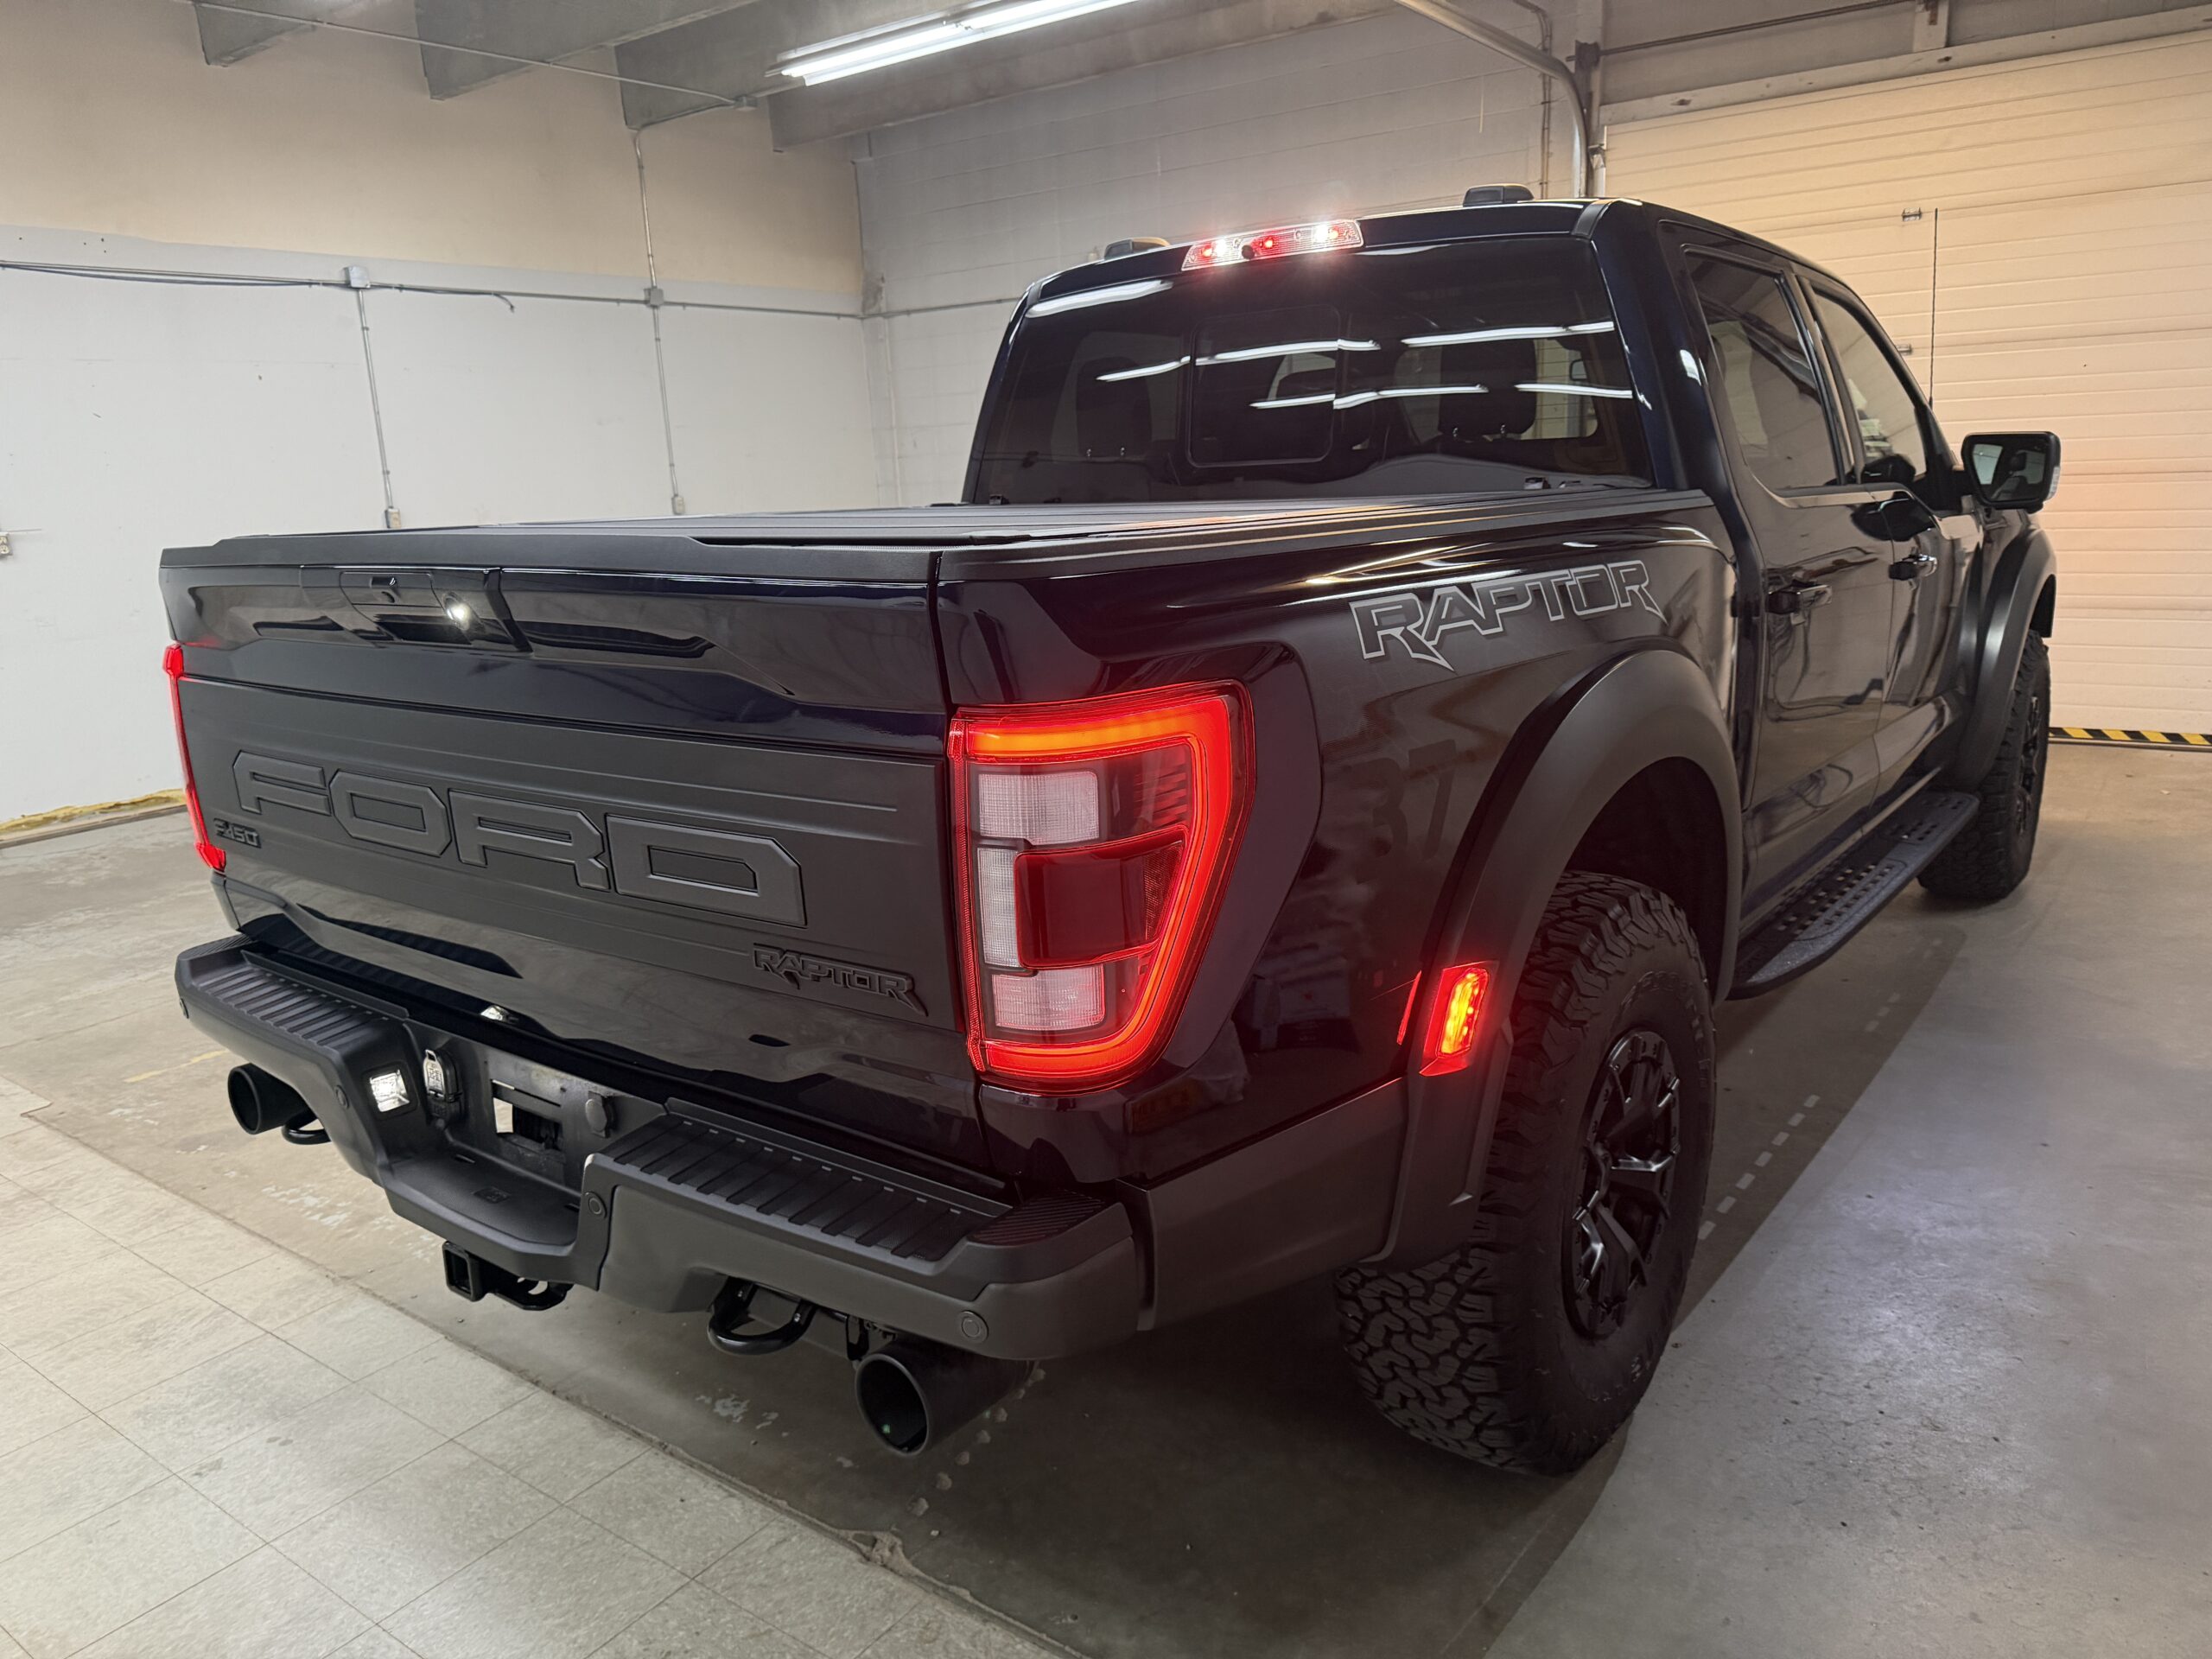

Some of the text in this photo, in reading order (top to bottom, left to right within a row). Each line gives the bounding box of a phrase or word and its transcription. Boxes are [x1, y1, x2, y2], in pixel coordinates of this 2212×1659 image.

[1350, 559, 1669, 671] RAPTOR
[232, 750, 806, 928] FORD
[753, 942, 928, 1017] RAPTOR
